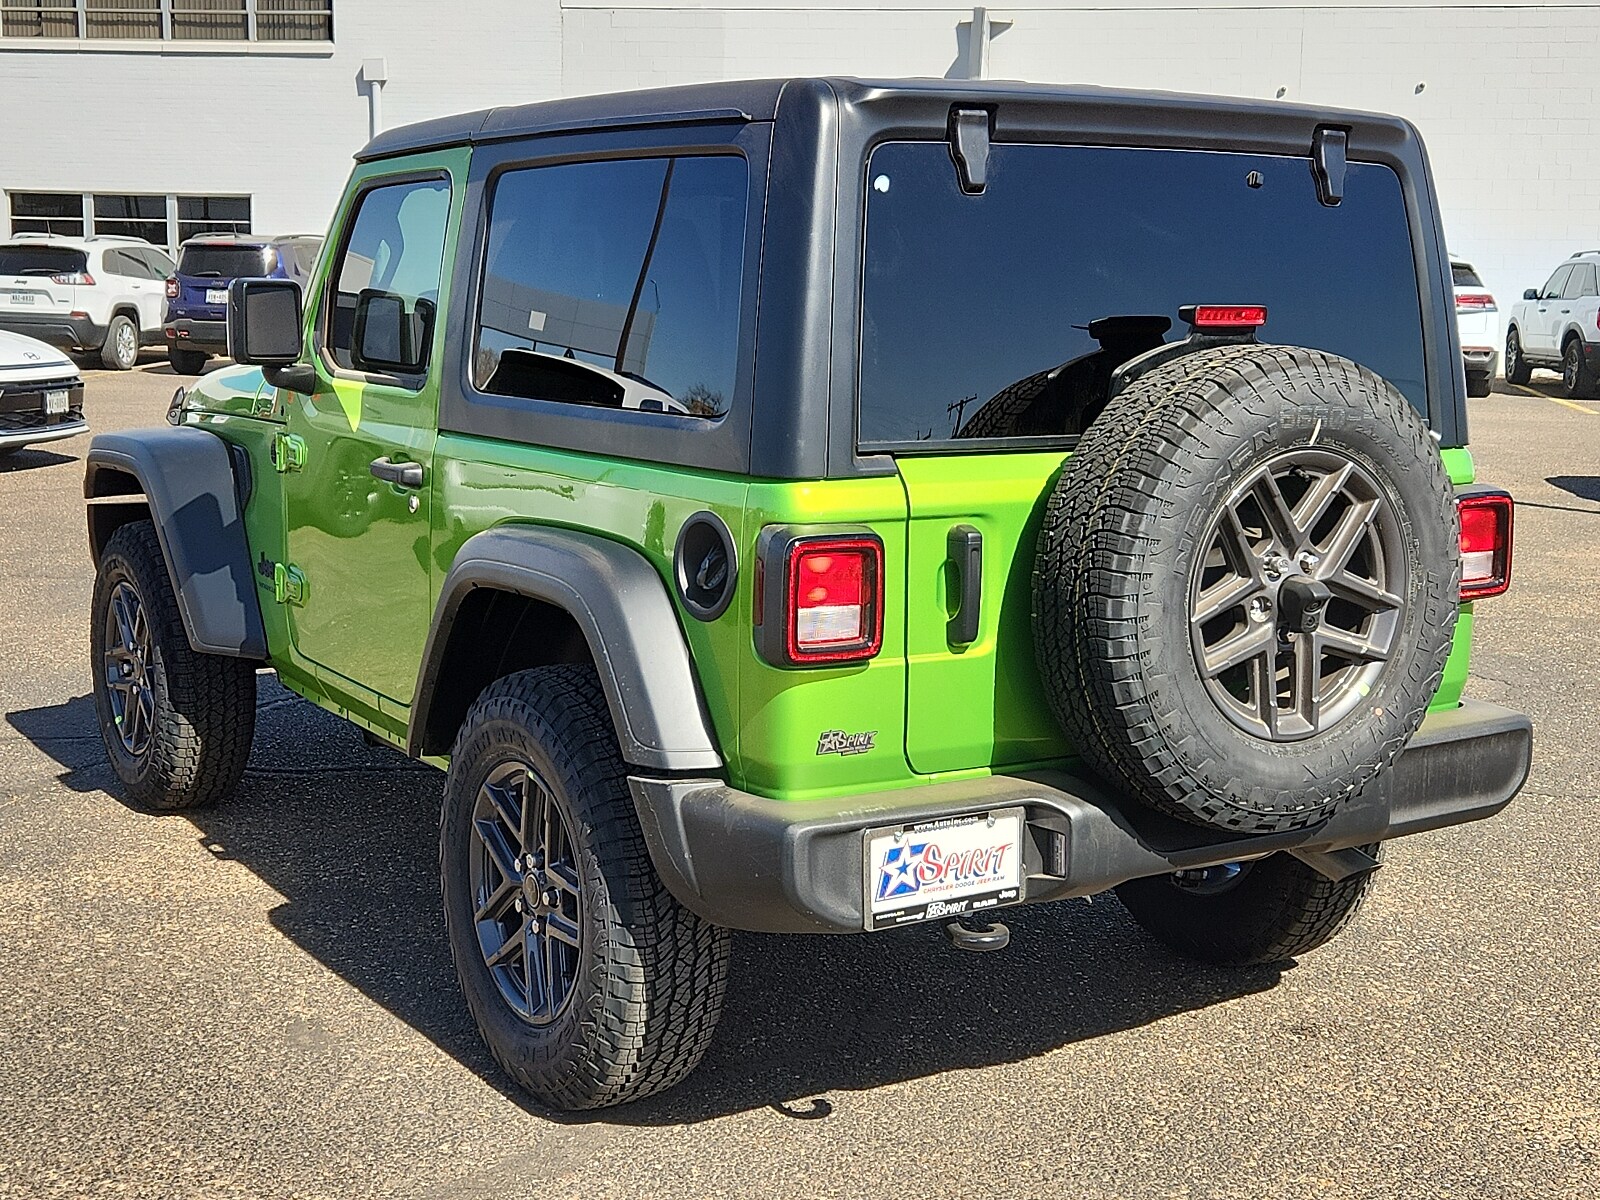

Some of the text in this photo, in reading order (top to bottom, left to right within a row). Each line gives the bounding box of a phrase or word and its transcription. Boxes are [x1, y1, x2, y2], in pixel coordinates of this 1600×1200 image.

[1173, 421, 1279, 576] NEXEN
[918, 841, 1014, 887] SPIRIT
[923, 883, 954, 894] CHRYSLER
[954, 880, 975, 889] DODGE
